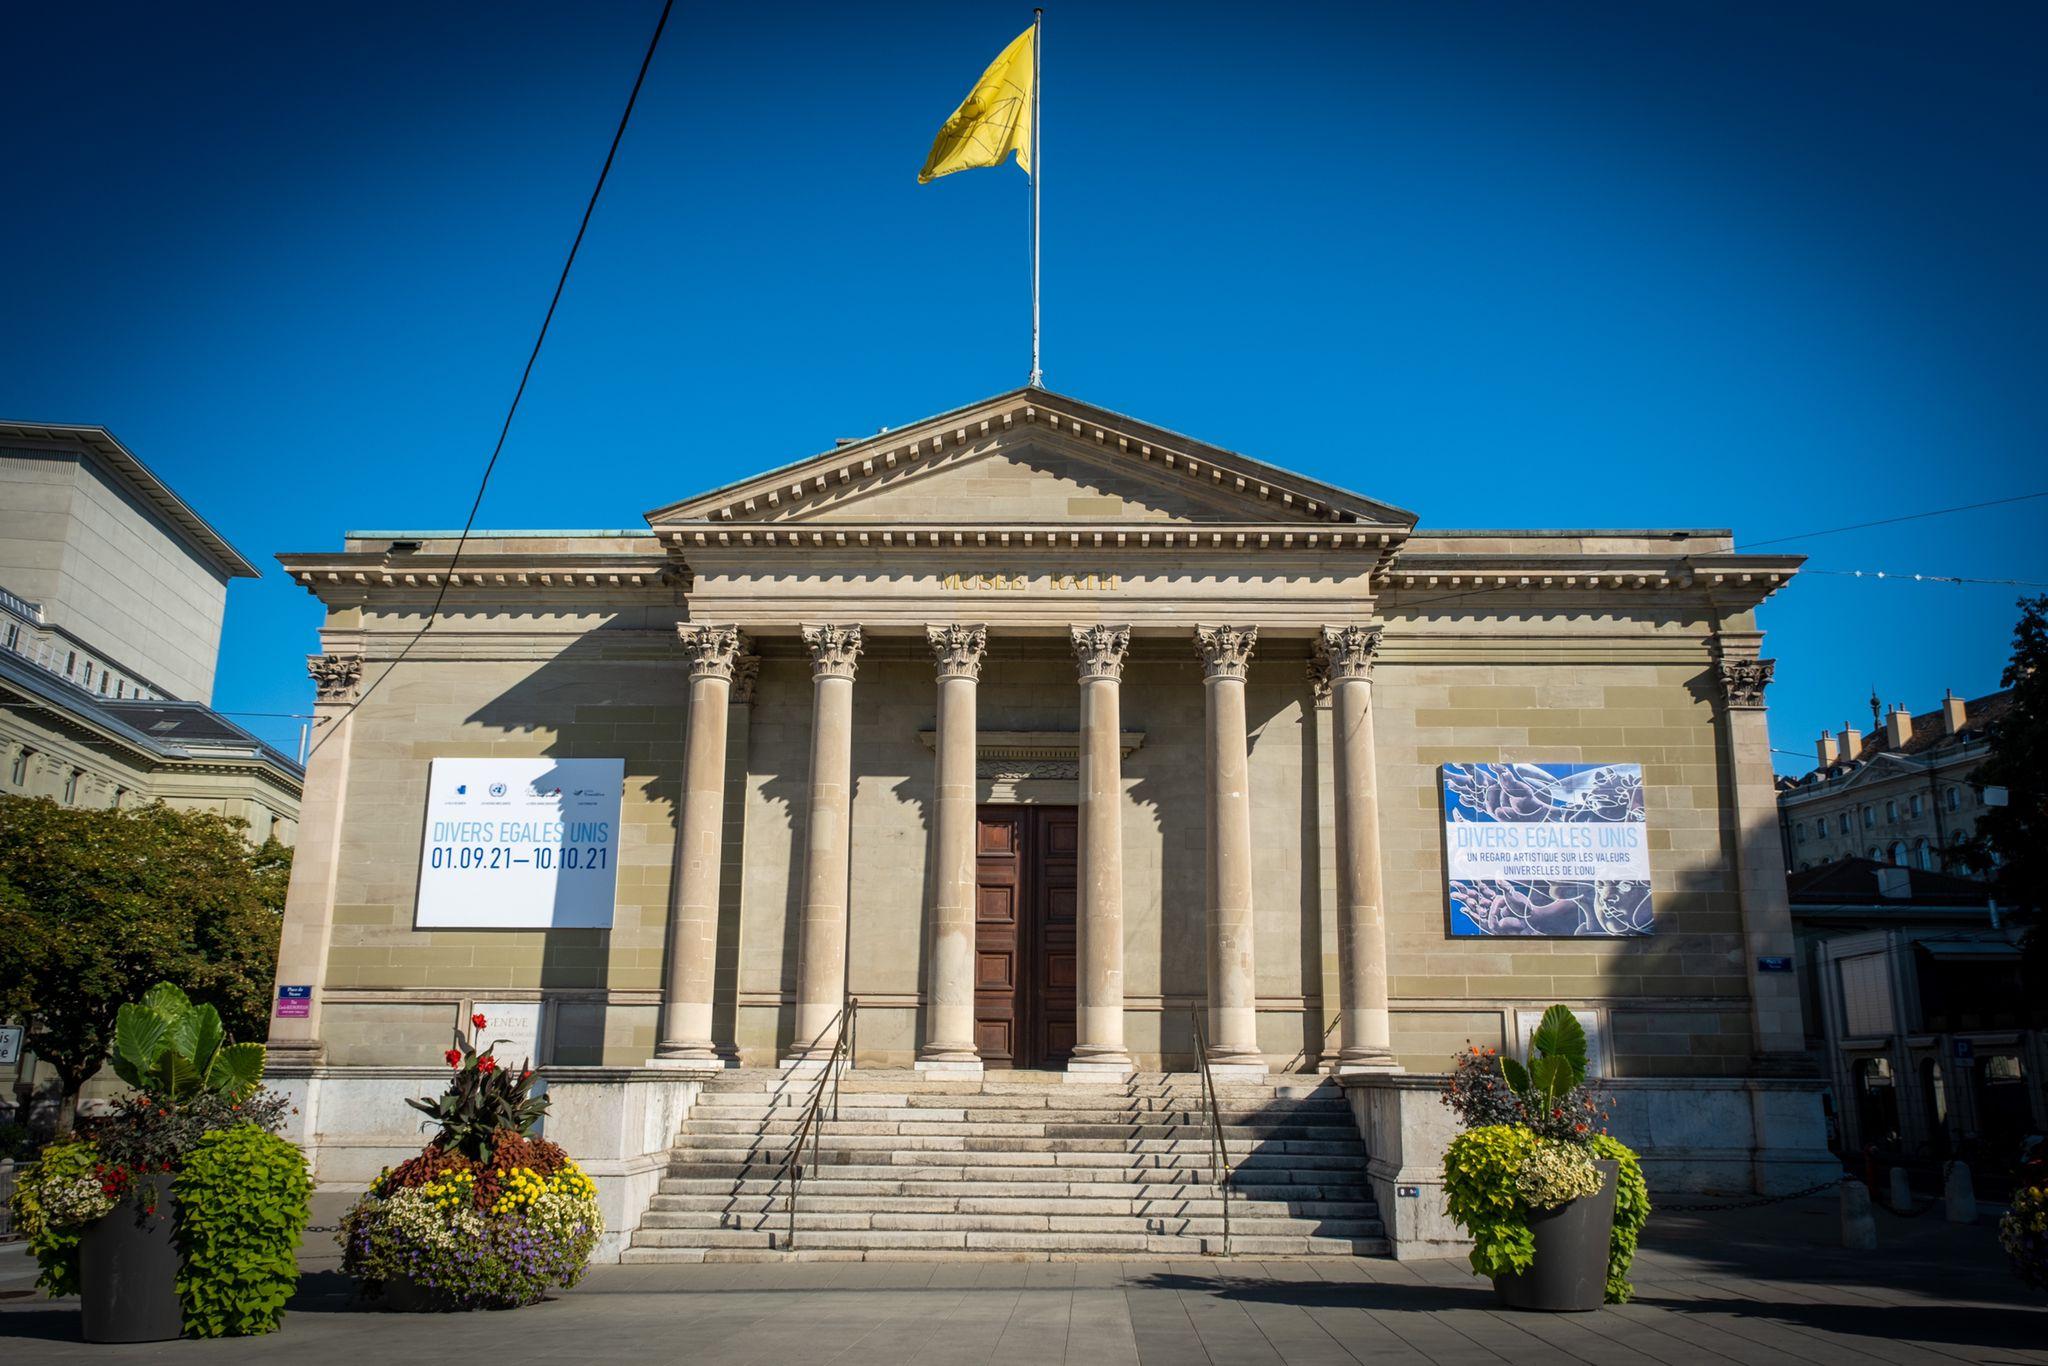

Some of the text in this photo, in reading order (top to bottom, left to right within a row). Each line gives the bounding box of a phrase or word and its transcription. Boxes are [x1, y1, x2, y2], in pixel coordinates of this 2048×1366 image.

[1050, 570, 1117, 590] RATH
[433, 822, 609, 843] DIVERS EGALES UNIS
[1457, 827, 1638, 848] DIVERS EGALES UNIS
[1467, 852, 1631, 862] UN REGARD ARTISTIQUE SUR LES VALEURS
[1503, 865, 1560, 876] UNIVERSELLES
[1562, 865, 1573, 876] DE
